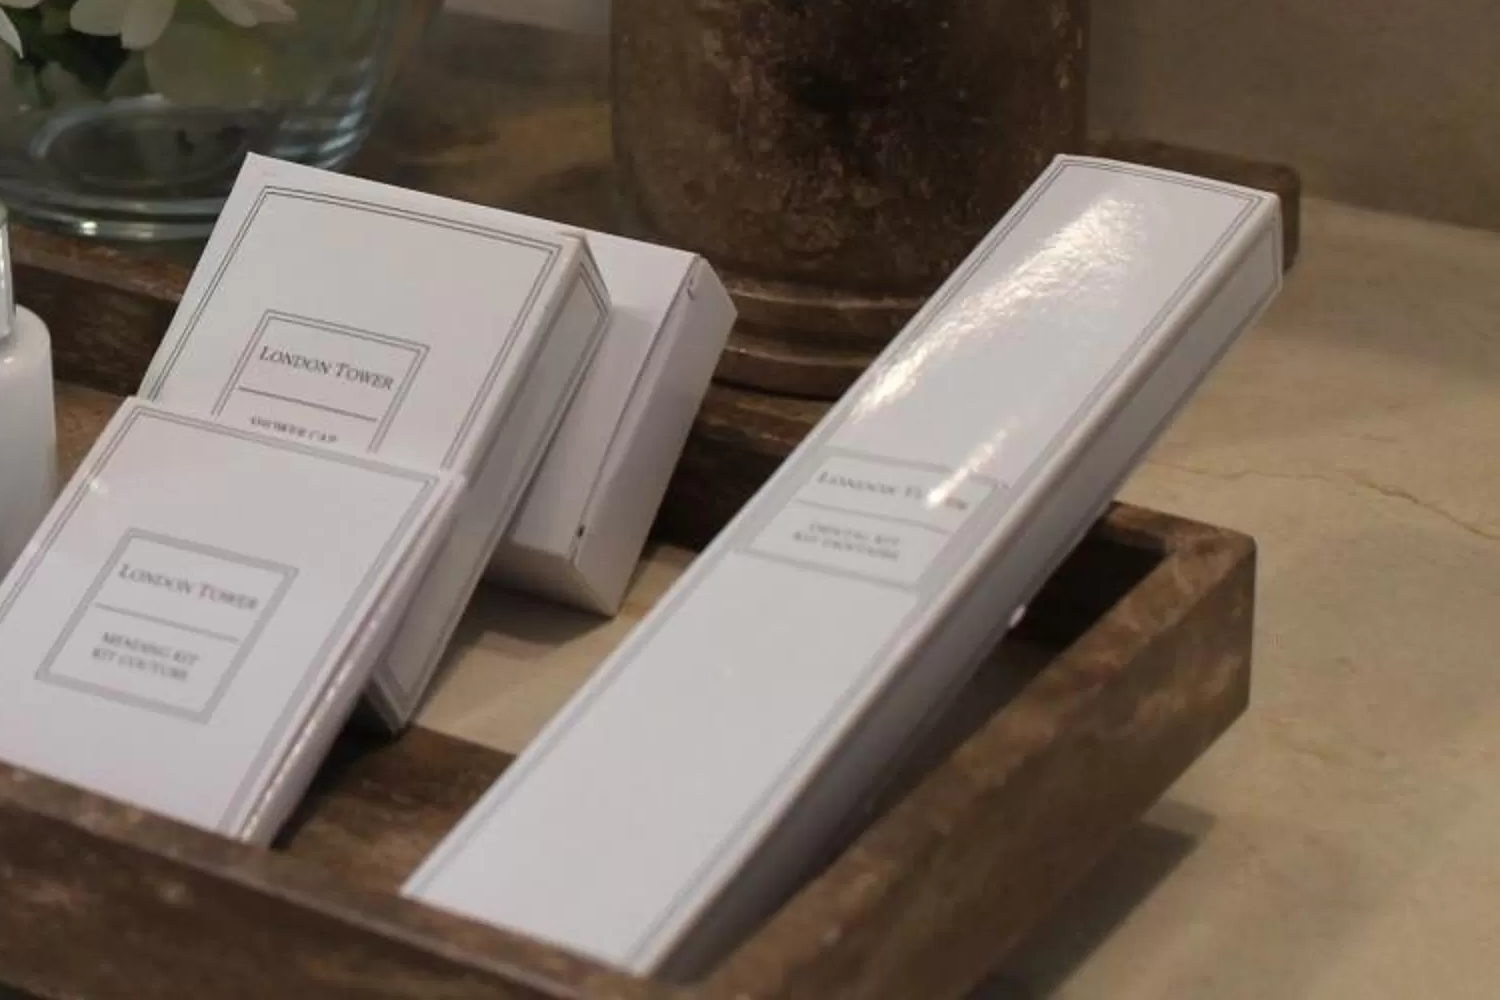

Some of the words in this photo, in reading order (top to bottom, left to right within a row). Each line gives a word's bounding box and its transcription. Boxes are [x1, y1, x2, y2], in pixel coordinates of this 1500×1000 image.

[259, 345, 332, 376] LONDON
[334, 361, 395, 392] TOWER
[118, 563, 191, 596] LONDON
[197, 582, 259, 611] TOWER
[91, 647, 116, 664] KIT
[173, 649, 199, 668] KIT
